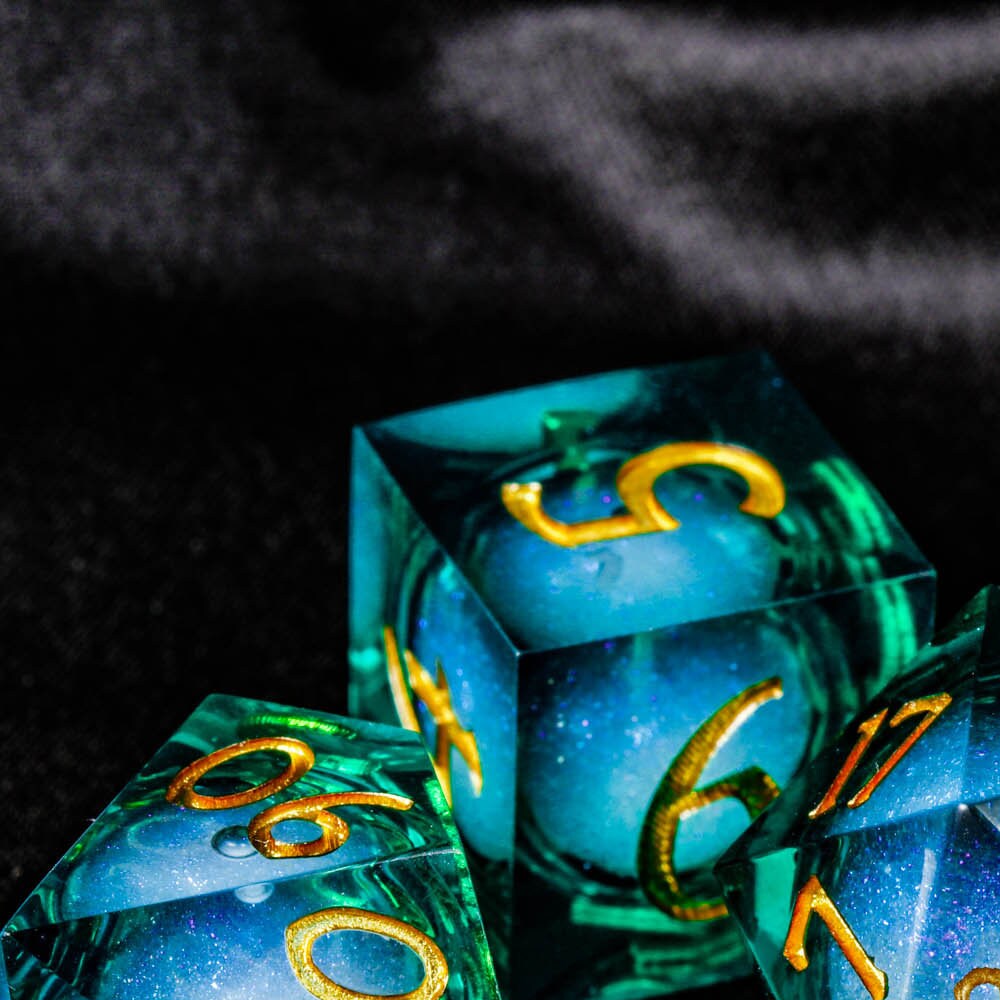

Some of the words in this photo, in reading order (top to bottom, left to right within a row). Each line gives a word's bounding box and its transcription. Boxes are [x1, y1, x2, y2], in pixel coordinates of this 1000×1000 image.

[502, 441, 785, 548] 5
[636, 675, 783, 921] 6
[808, 692, 953, 819] 17
